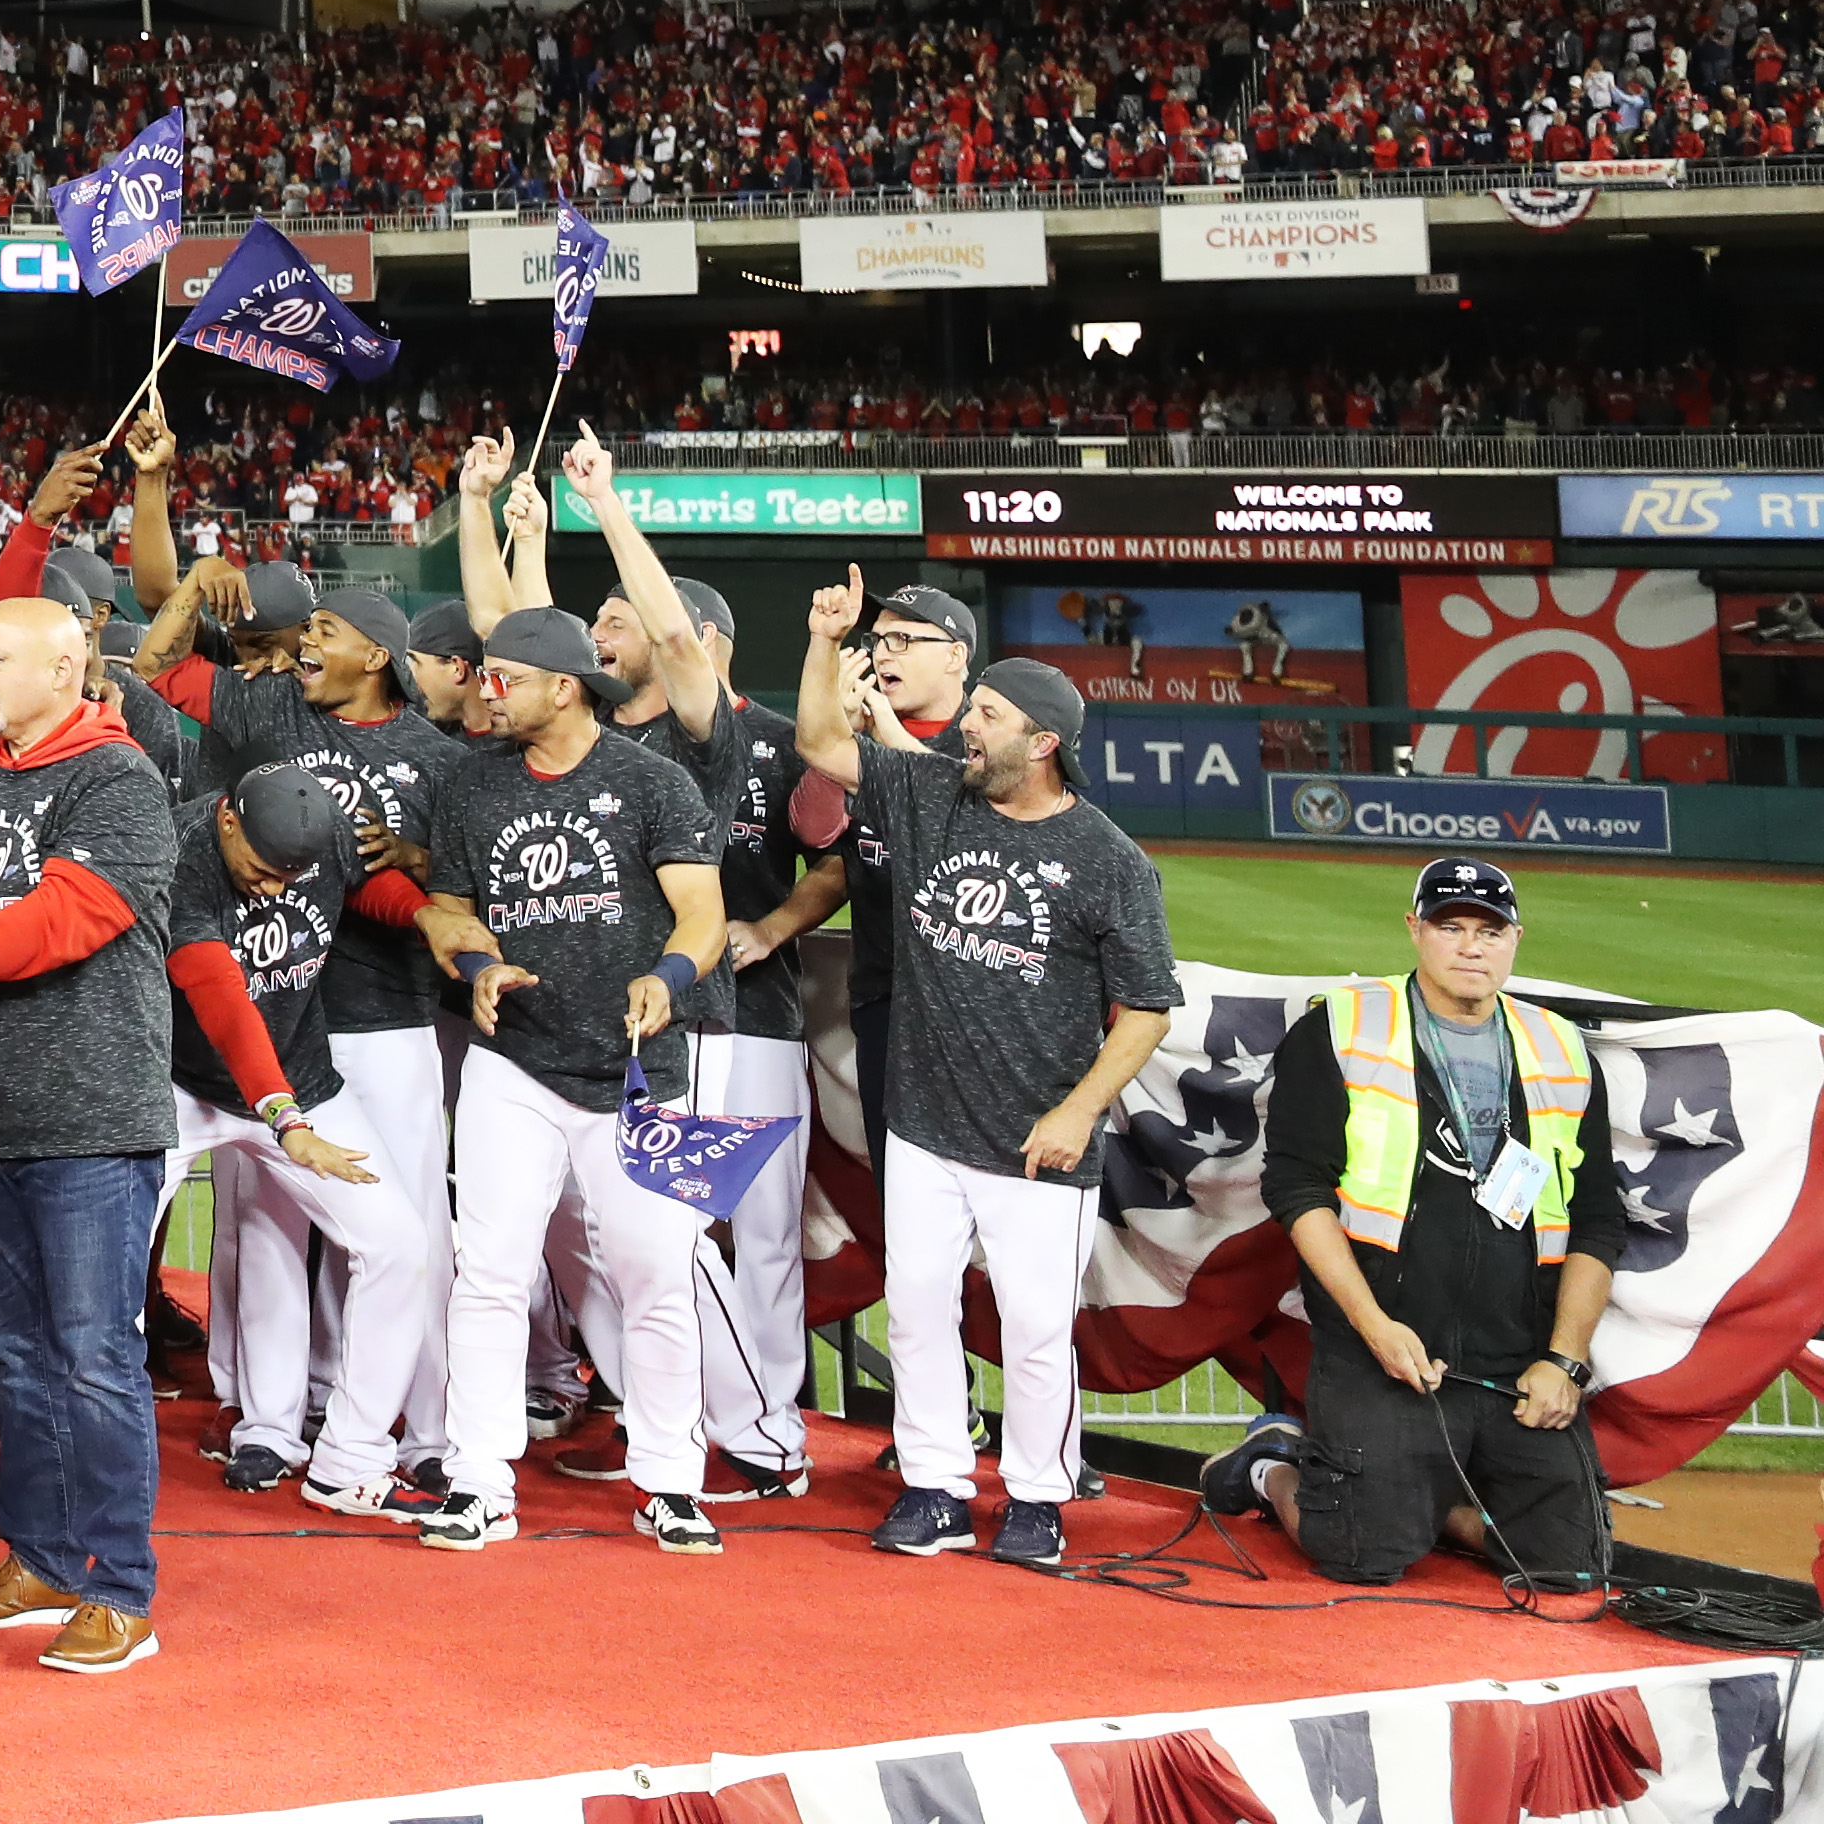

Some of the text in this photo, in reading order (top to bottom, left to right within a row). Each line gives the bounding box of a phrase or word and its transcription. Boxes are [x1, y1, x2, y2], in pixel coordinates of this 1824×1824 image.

[1206, 223, 1378, 249] CHAMPIONS
[1221, 208, 1360, 224] NL EAST DIVISION
[856, 243, 986, 272] CHAMPIONS
[221, 266, 311, 322] NATION
[193, 325, 329, 390] CHAMPS
[623, 488, 908, 524] Harris Teeter
[963, 491, 1062, 523] 11:20
[1234, 484, 1403, 507] WELCOME TO
[1216, 511, 1433, 532] NATIONALS PARK
[968, 536, 1505, 562] WASHINGTON NATIONALS DREAM FOUNDATION
[1104, 740, 1241, 787] LTA
[359, 764, 404, 836] LEAGU
[1355, 800, 1500, 840] Choose
[1564, 816, 1643, 838] va.gov
[488, 811, 620, 897] NATIONAL LEAGUE
[275, 890, 333, 947] LEAGUE
[488, 892, 623, 934] CHAMPS
[914, 849, 1051, 948] NATIONAL LEAGUE
